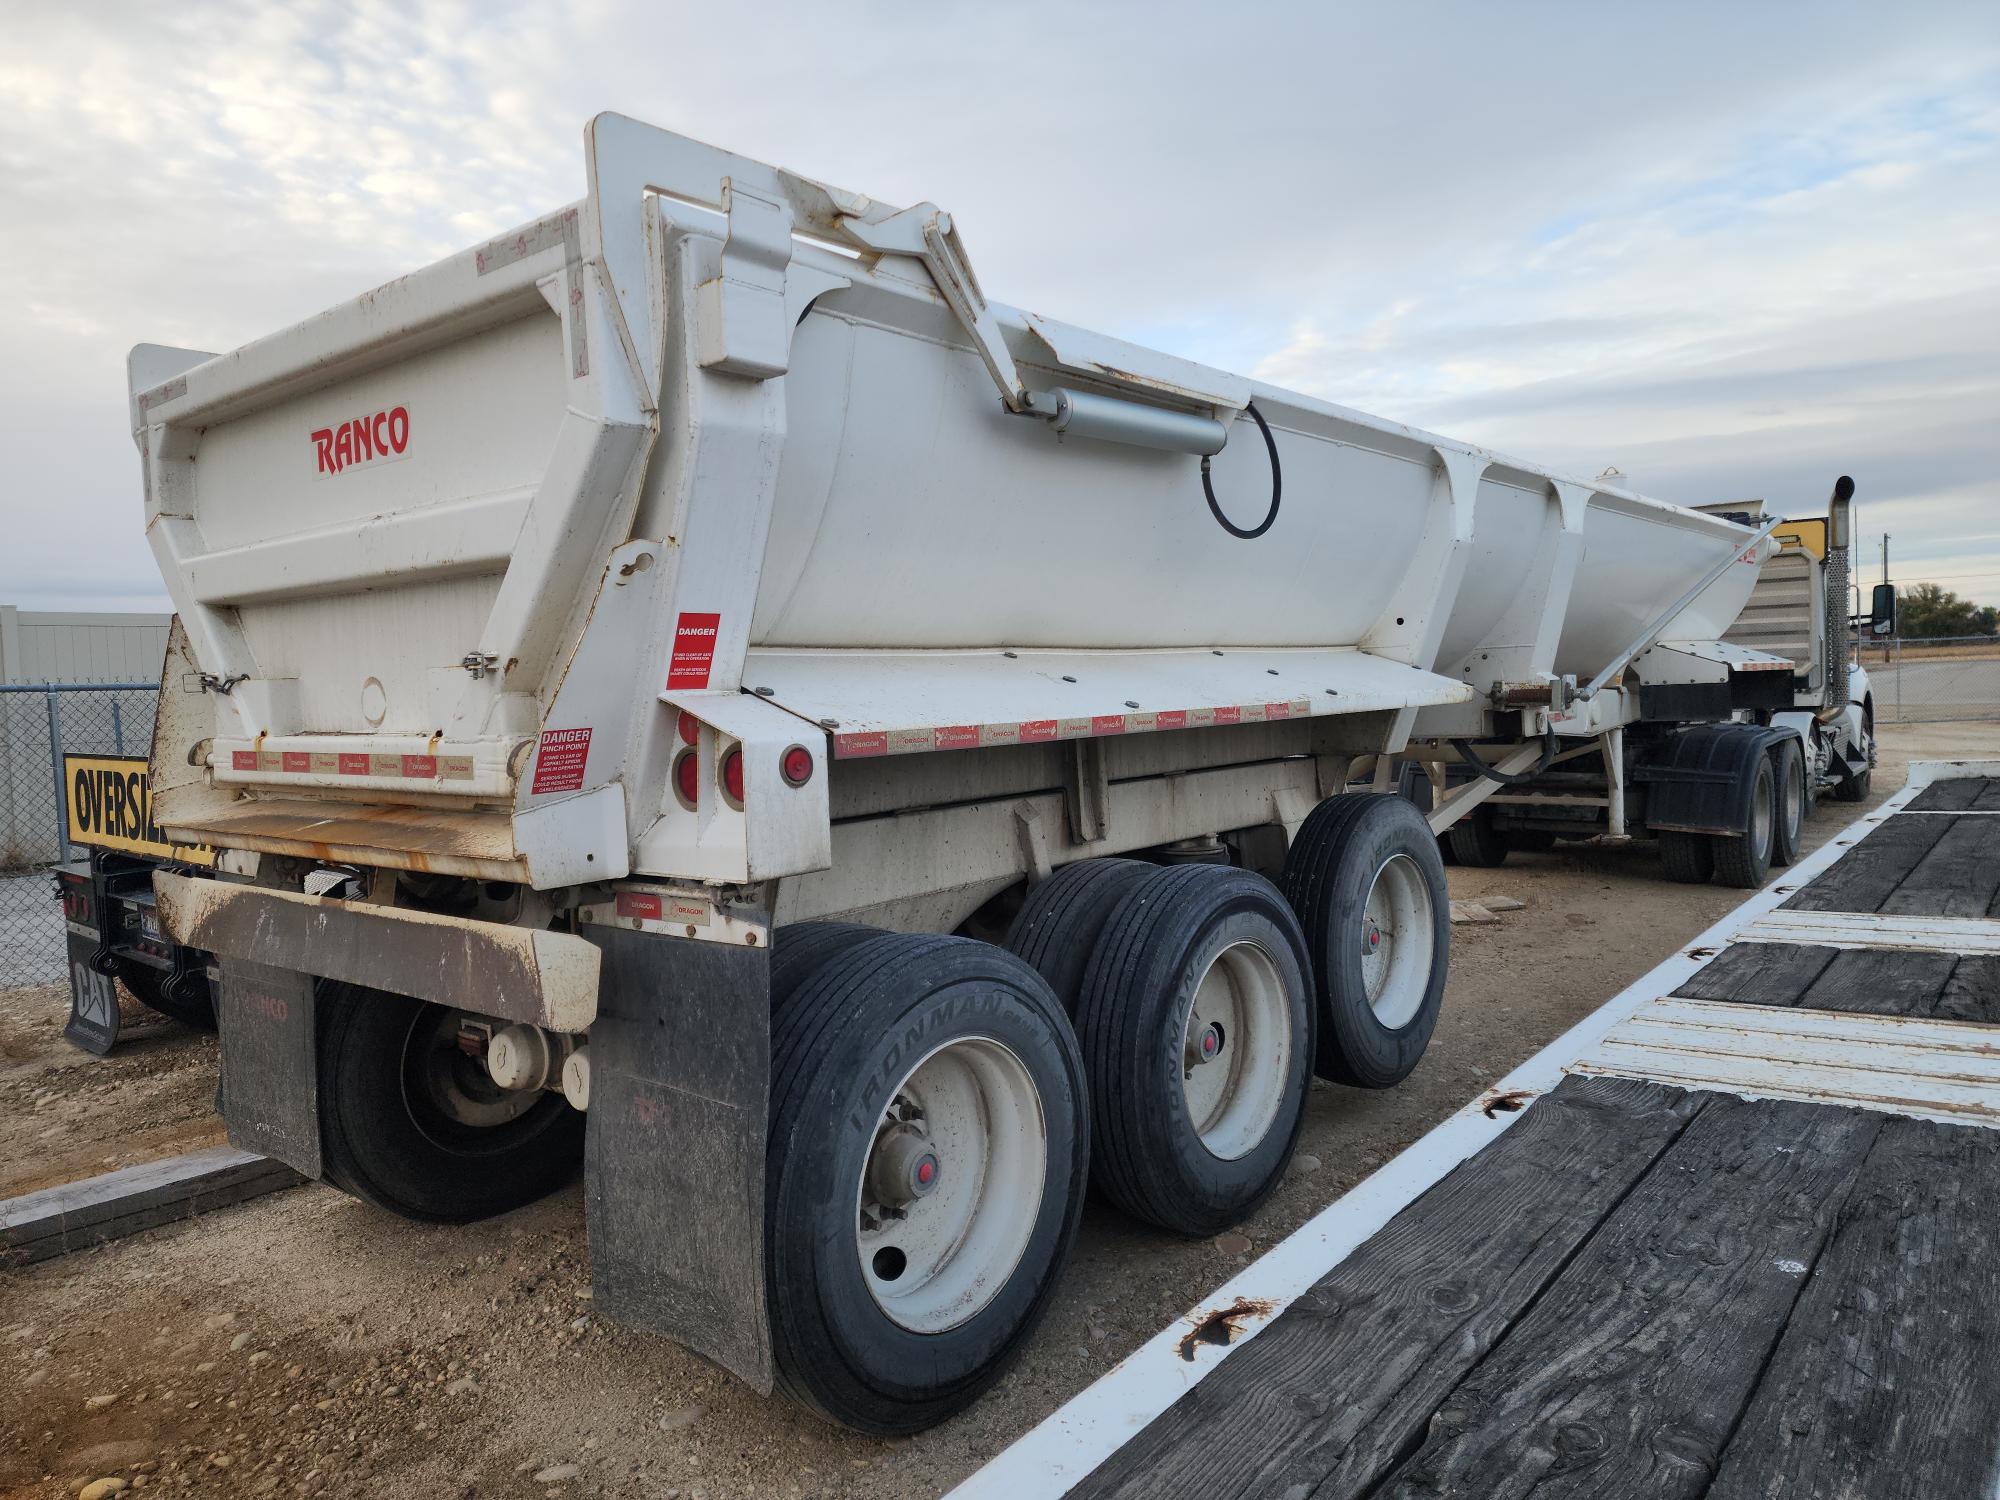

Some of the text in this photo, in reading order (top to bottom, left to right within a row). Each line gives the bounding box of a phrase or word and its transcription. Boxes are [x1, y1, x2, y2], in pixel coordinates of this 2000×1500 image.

[311, 406, 409, 475] RANCO
[678, 627, 716, 636] DANGER
[541, 743, 587, 752] PINCH POINT
[542, 730, 590, 744] DANGER
[75, 768, 168, 845] OVERSI
[631, 901, 704, 916] DRAGON DRAGON
[75, 962, 111, 1028] CAT
[851, 995, 1002, 1132] IRONMAN
